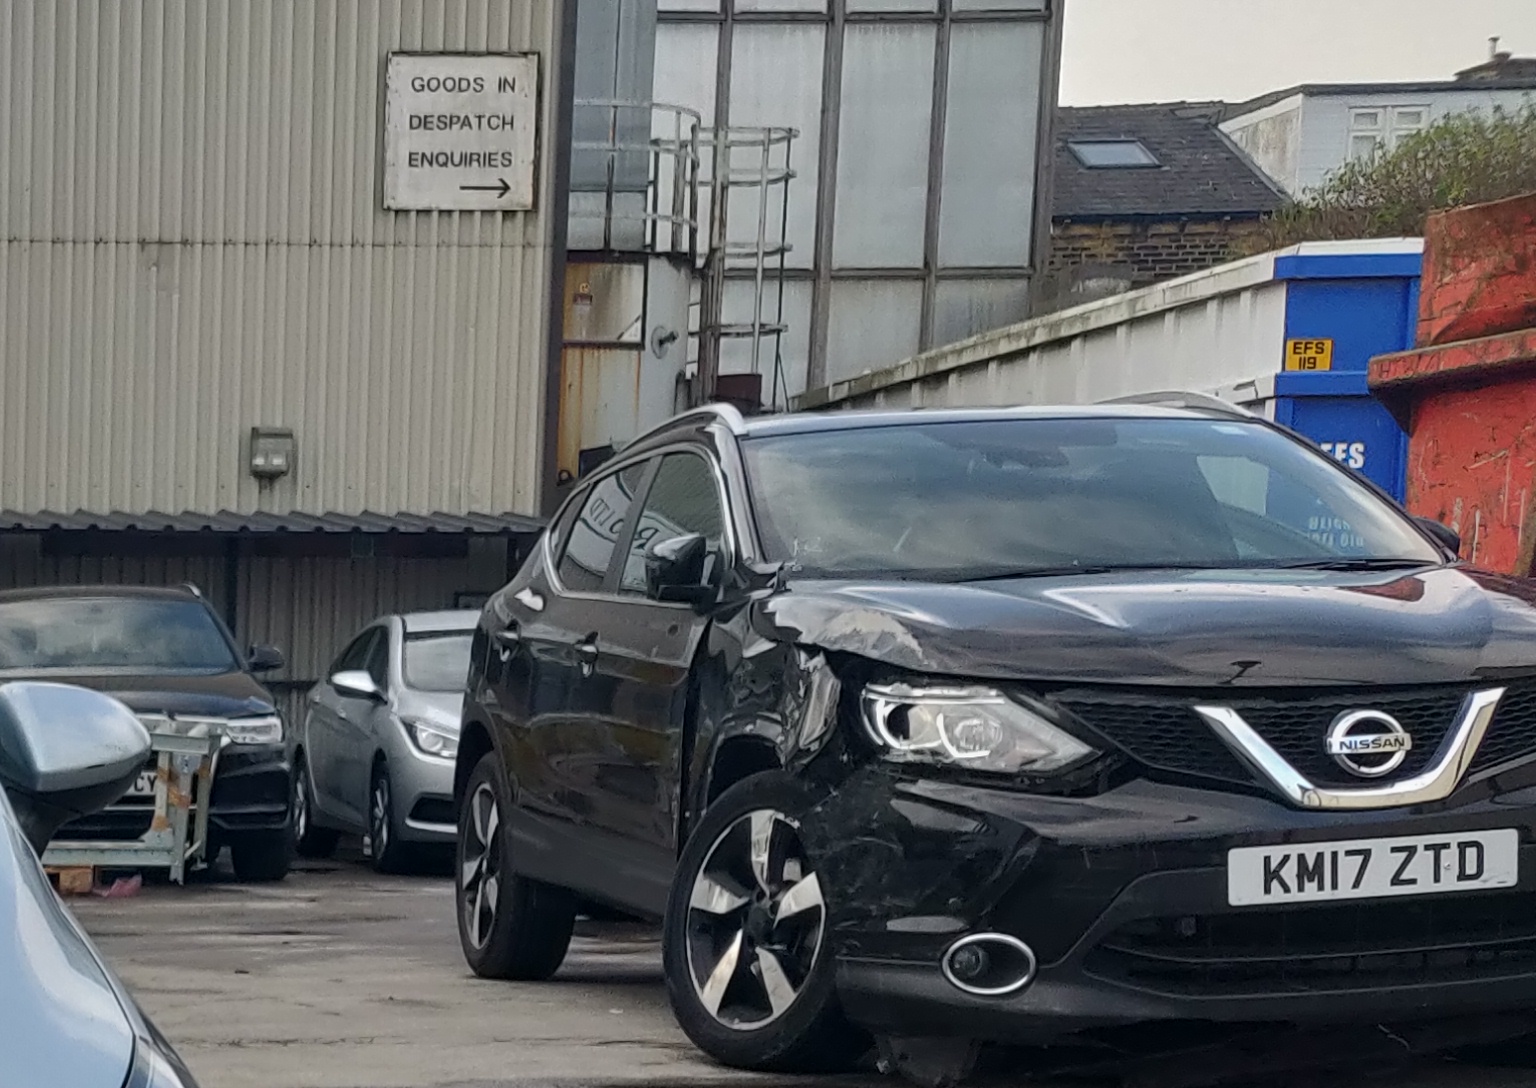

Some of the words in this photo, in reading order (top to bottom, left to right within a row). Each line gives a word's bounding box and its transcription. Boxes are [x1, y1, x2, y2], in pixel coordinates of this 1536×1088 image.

[411, 76, 485, 93] GOODS
[497, 76, 516, 93] IN
[409, 114, 514, 131] DESPATCH
[408, 151, 513, 168] ENQUIRIES
[1293, 341, 1325, 355] EFS
[1298, 356, 1317, 370] 119
[1339, 737, 1405, 751] NISSAN
[1263, 847, 1373, 896] KM17
[1389, 839, 1485, 887] ZTD
